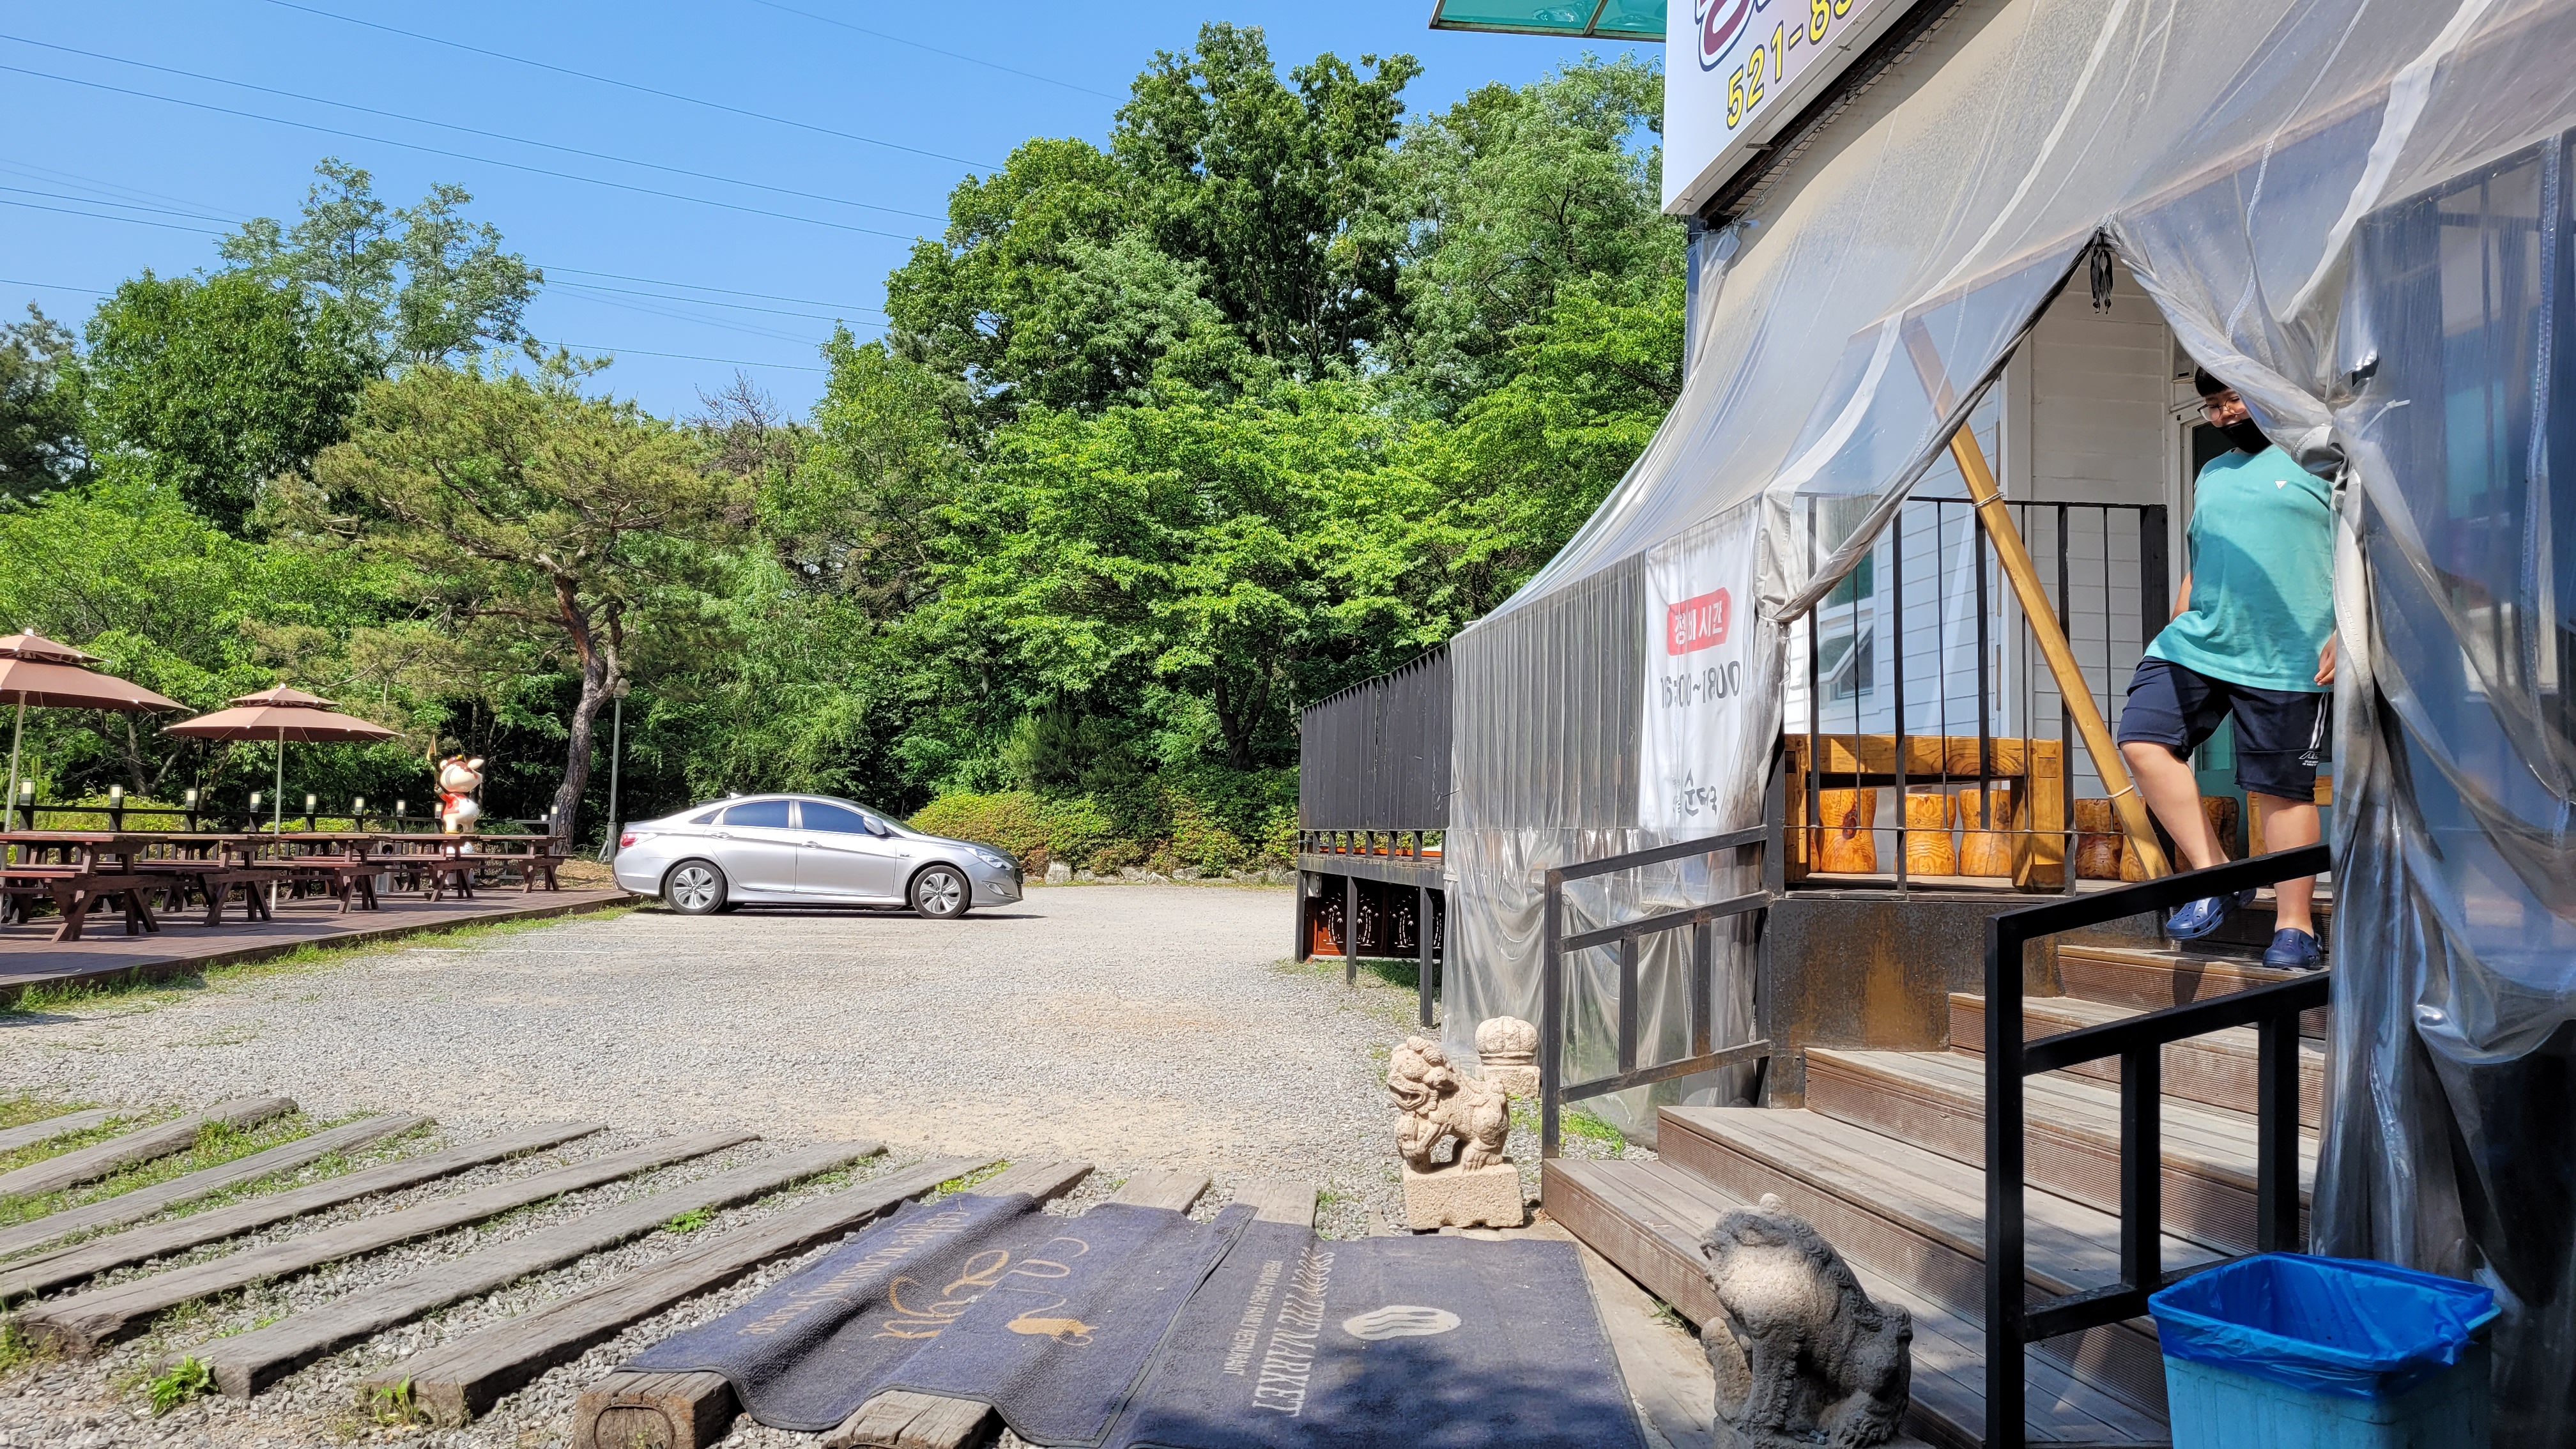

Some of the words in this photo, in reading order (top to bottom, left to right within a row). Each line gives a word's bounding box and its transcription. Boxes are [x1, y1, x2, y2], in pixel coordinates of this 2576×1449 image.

[1259, 1260, 1283, 1285] PREMIUM
[1290, 1246, 1335, 1298] SPOON
[1248, 1285, 1274, 1305] SHABU
[1277, 1294, 1326, 1331] THE
[1239, 1306, 1266, 1328] FAMILY
[1222, 1329, 1259, 1376] RESTAURANT
[1252, 1328, 1319, 1418] MARKET
